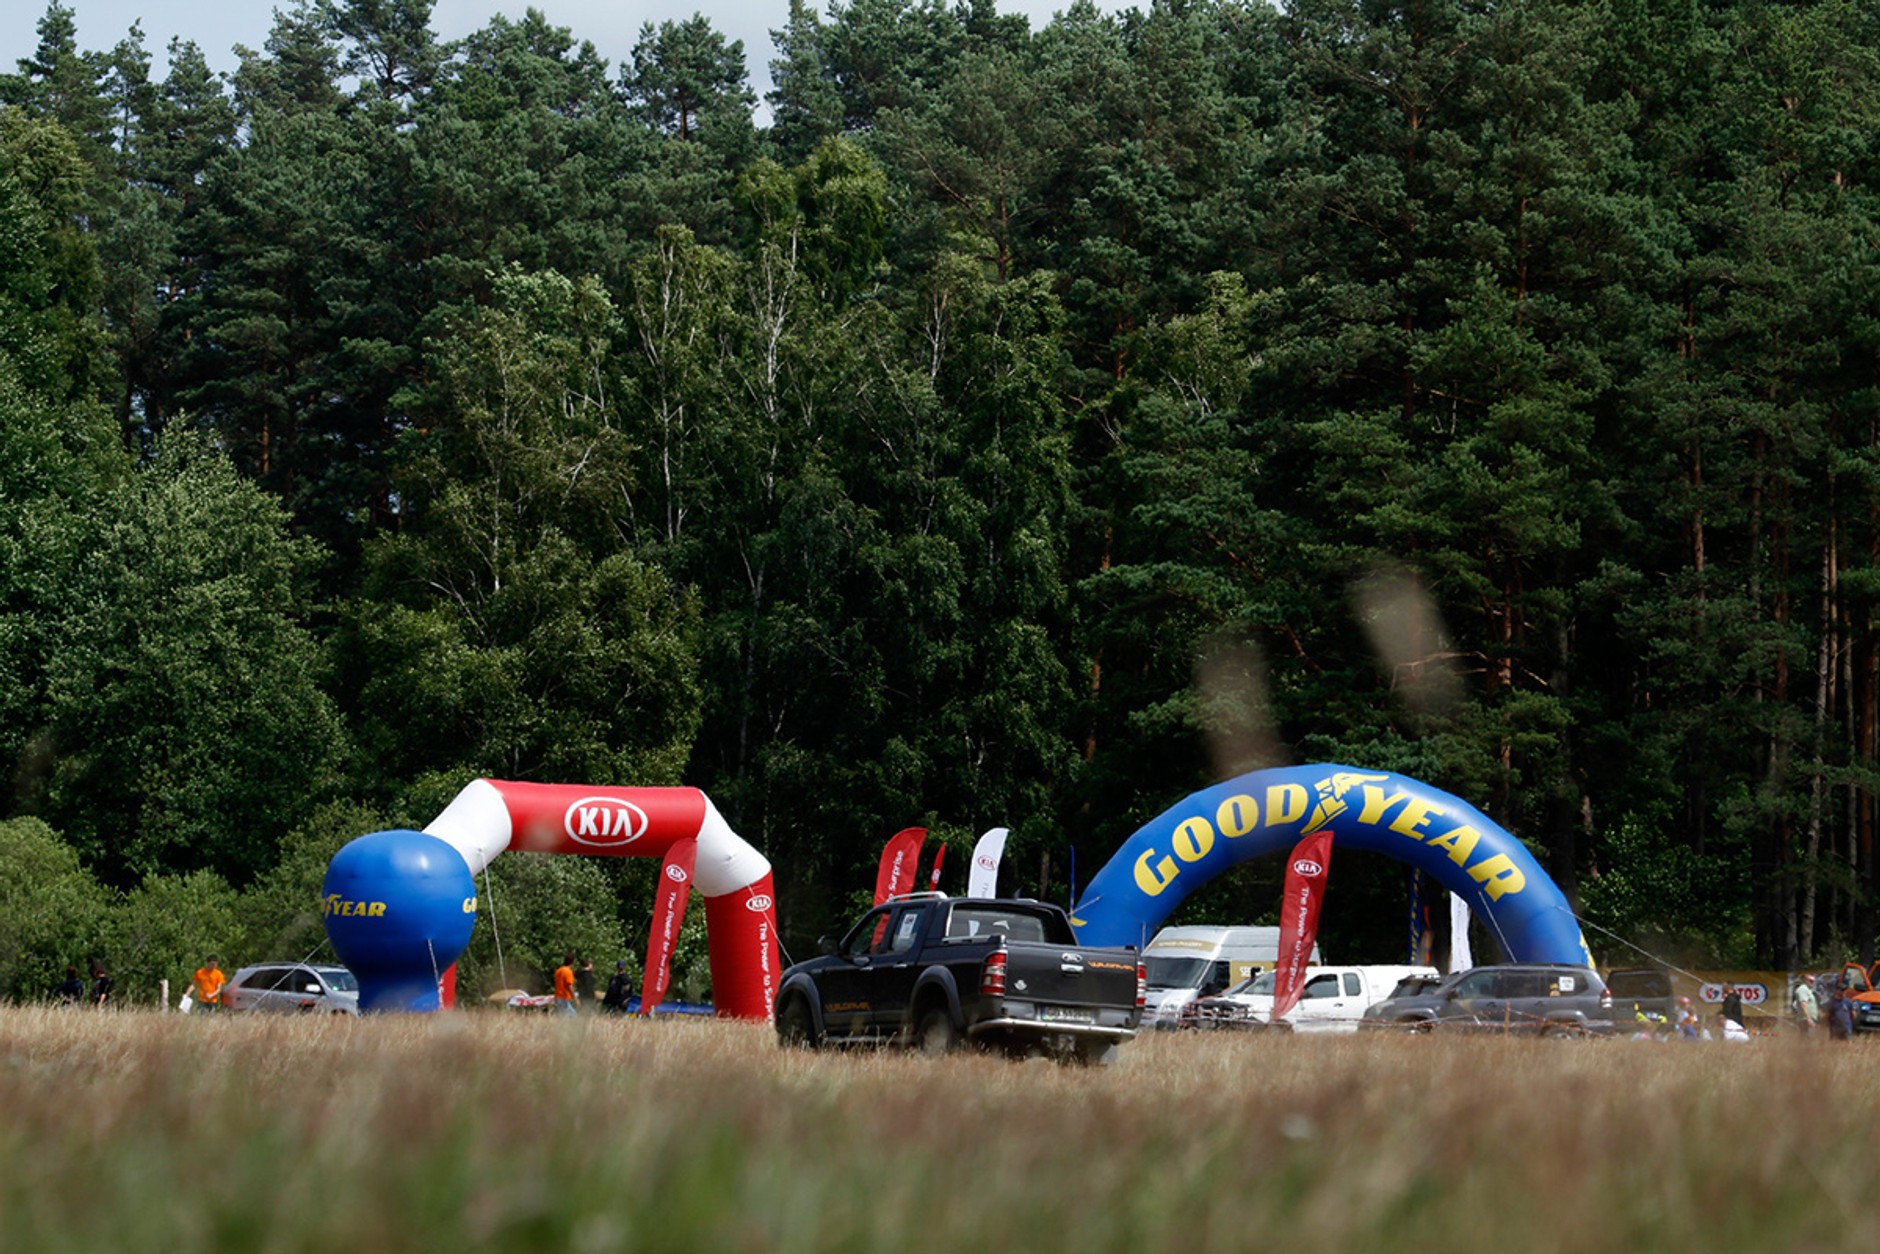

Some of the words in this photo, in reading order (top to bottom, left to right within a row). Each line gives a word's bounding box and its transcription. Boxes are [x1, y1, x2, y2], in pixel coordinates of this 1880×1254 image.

[578, 807, 633, 837] KIA
[1133, 783, 1309, 897] GOOD
[1356, 784, 1526, 903] YEAR
[888, 849, 904, 891] Surprise
[1297, 862, 1318, 874] KIA
[1299, 887, 1309, 905] The
[759, 922, 767, 940] The
[761, 942, 769, 972] Power
[763, 974, 771, 986] to
